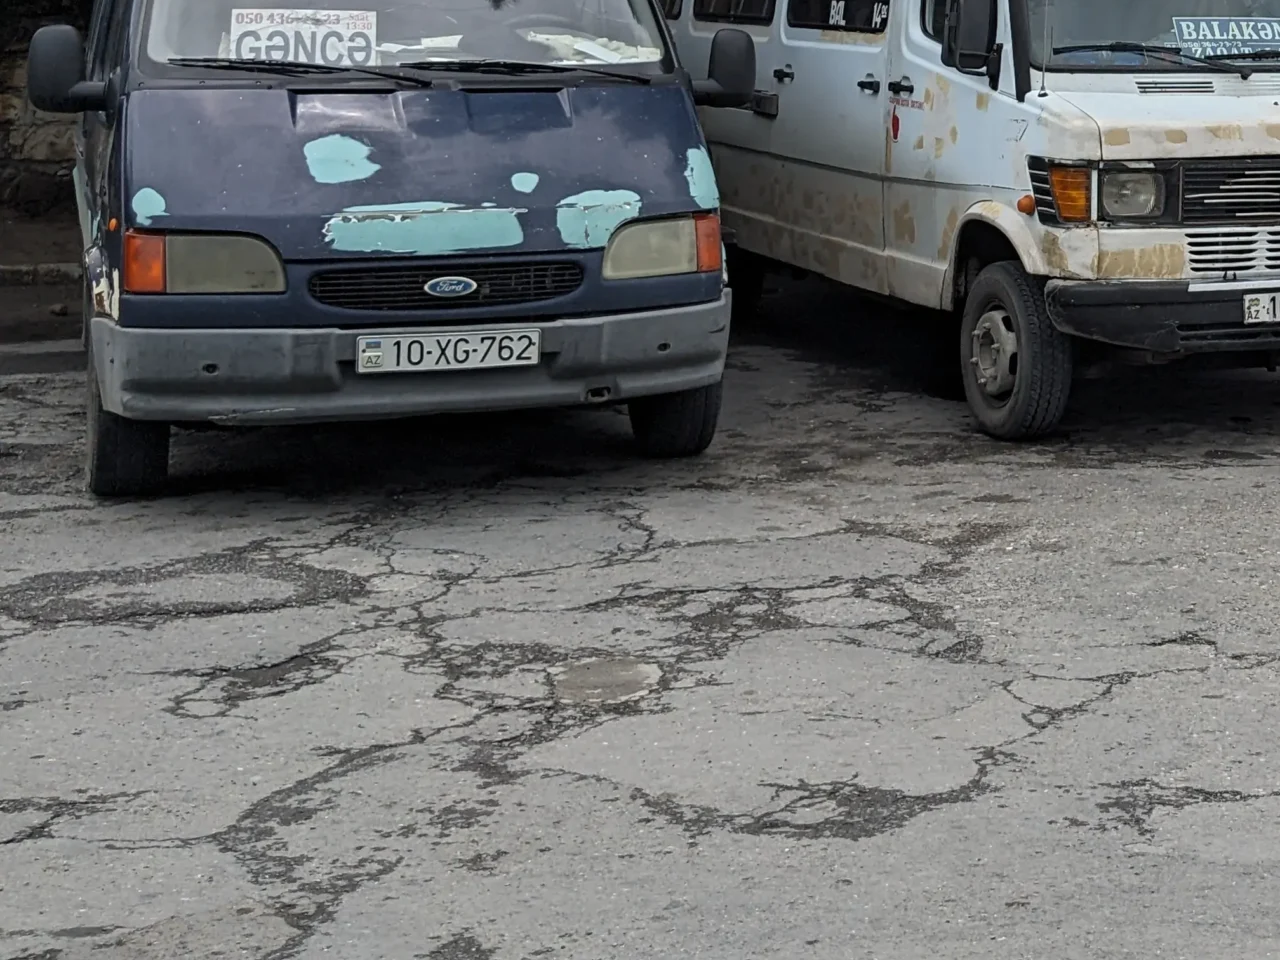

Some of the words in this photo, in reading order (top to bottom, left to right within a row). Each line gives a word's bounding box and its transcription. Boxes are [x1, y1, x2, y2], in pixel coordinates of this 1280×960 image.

[235, 12, 264, 25] 050
[828, 0, 846, 26] BAL
[346, 21, 372, 31] 13:30
[235, 29, 372, 66] GƏNCƏ
[436, 280, 464, 291] Ford
[1246, 309, 1260, 320] AZ
[365, 354, 381, 365] AZ
[392, 334, 533, 367] 10-XG-762
